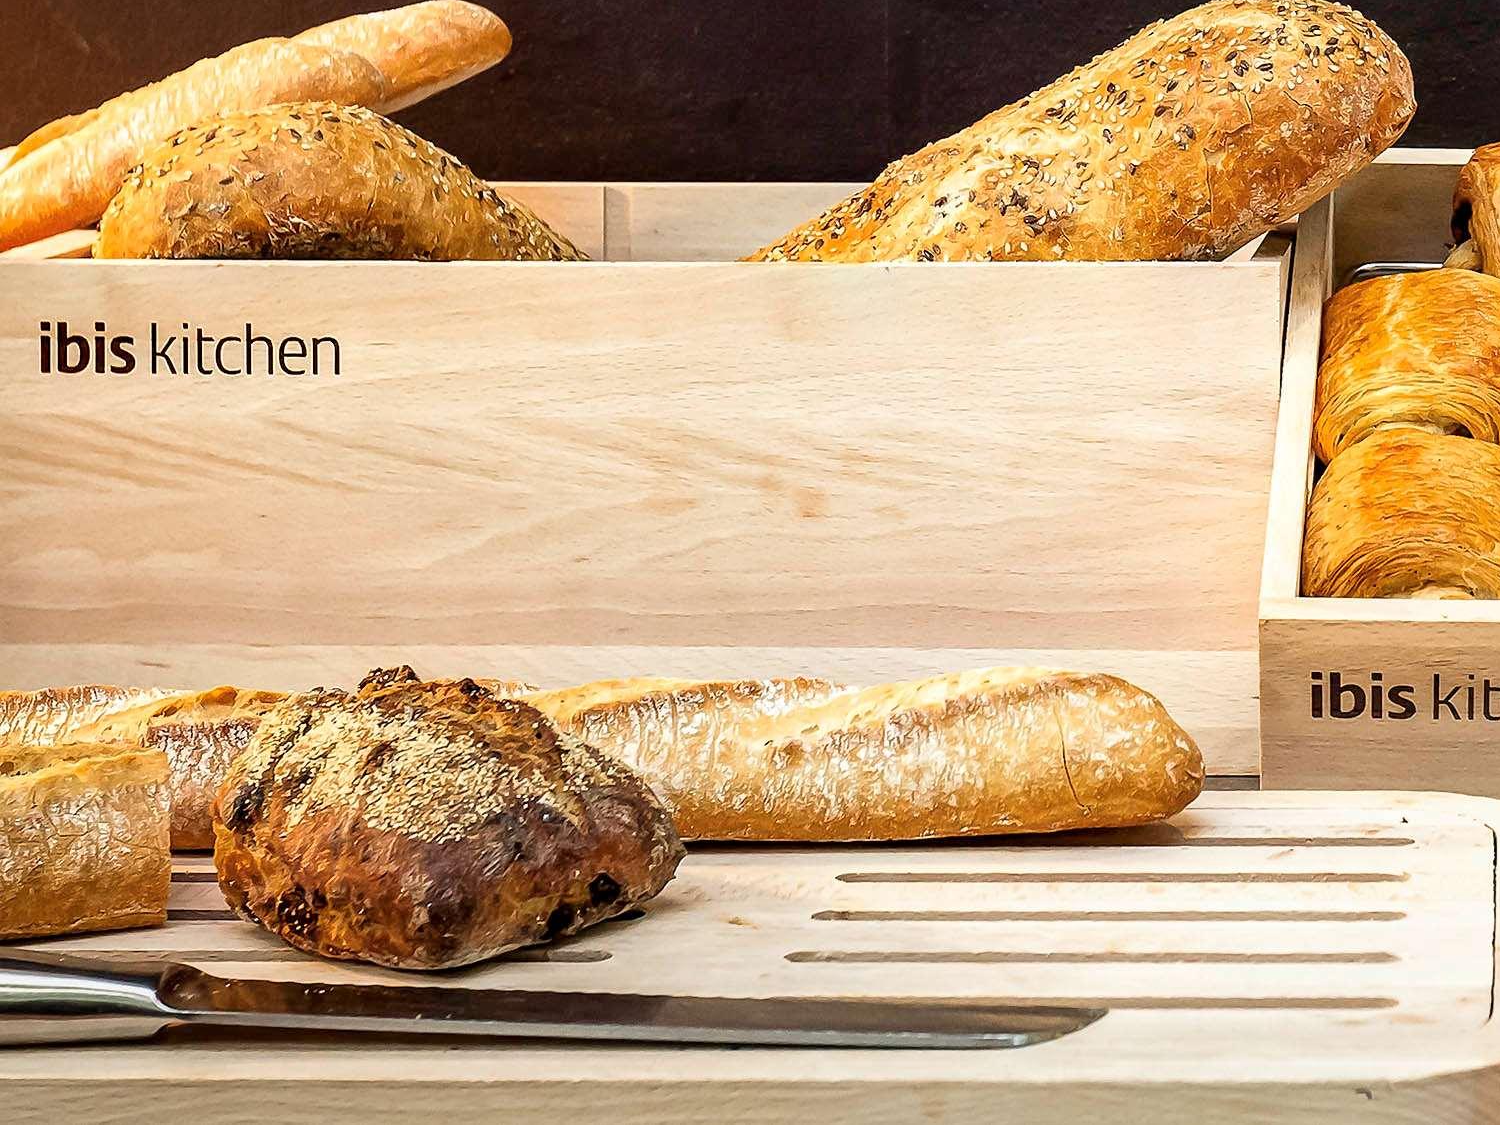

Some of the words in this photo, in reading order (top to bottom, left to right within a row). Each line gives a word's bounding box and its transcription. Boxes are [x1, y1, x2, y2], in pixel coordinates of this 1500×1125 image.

[40, 321, 136, 374] ibis
[151, 322, 340, 376] kitchen
[1310, 671, 1417, 720] ibis
